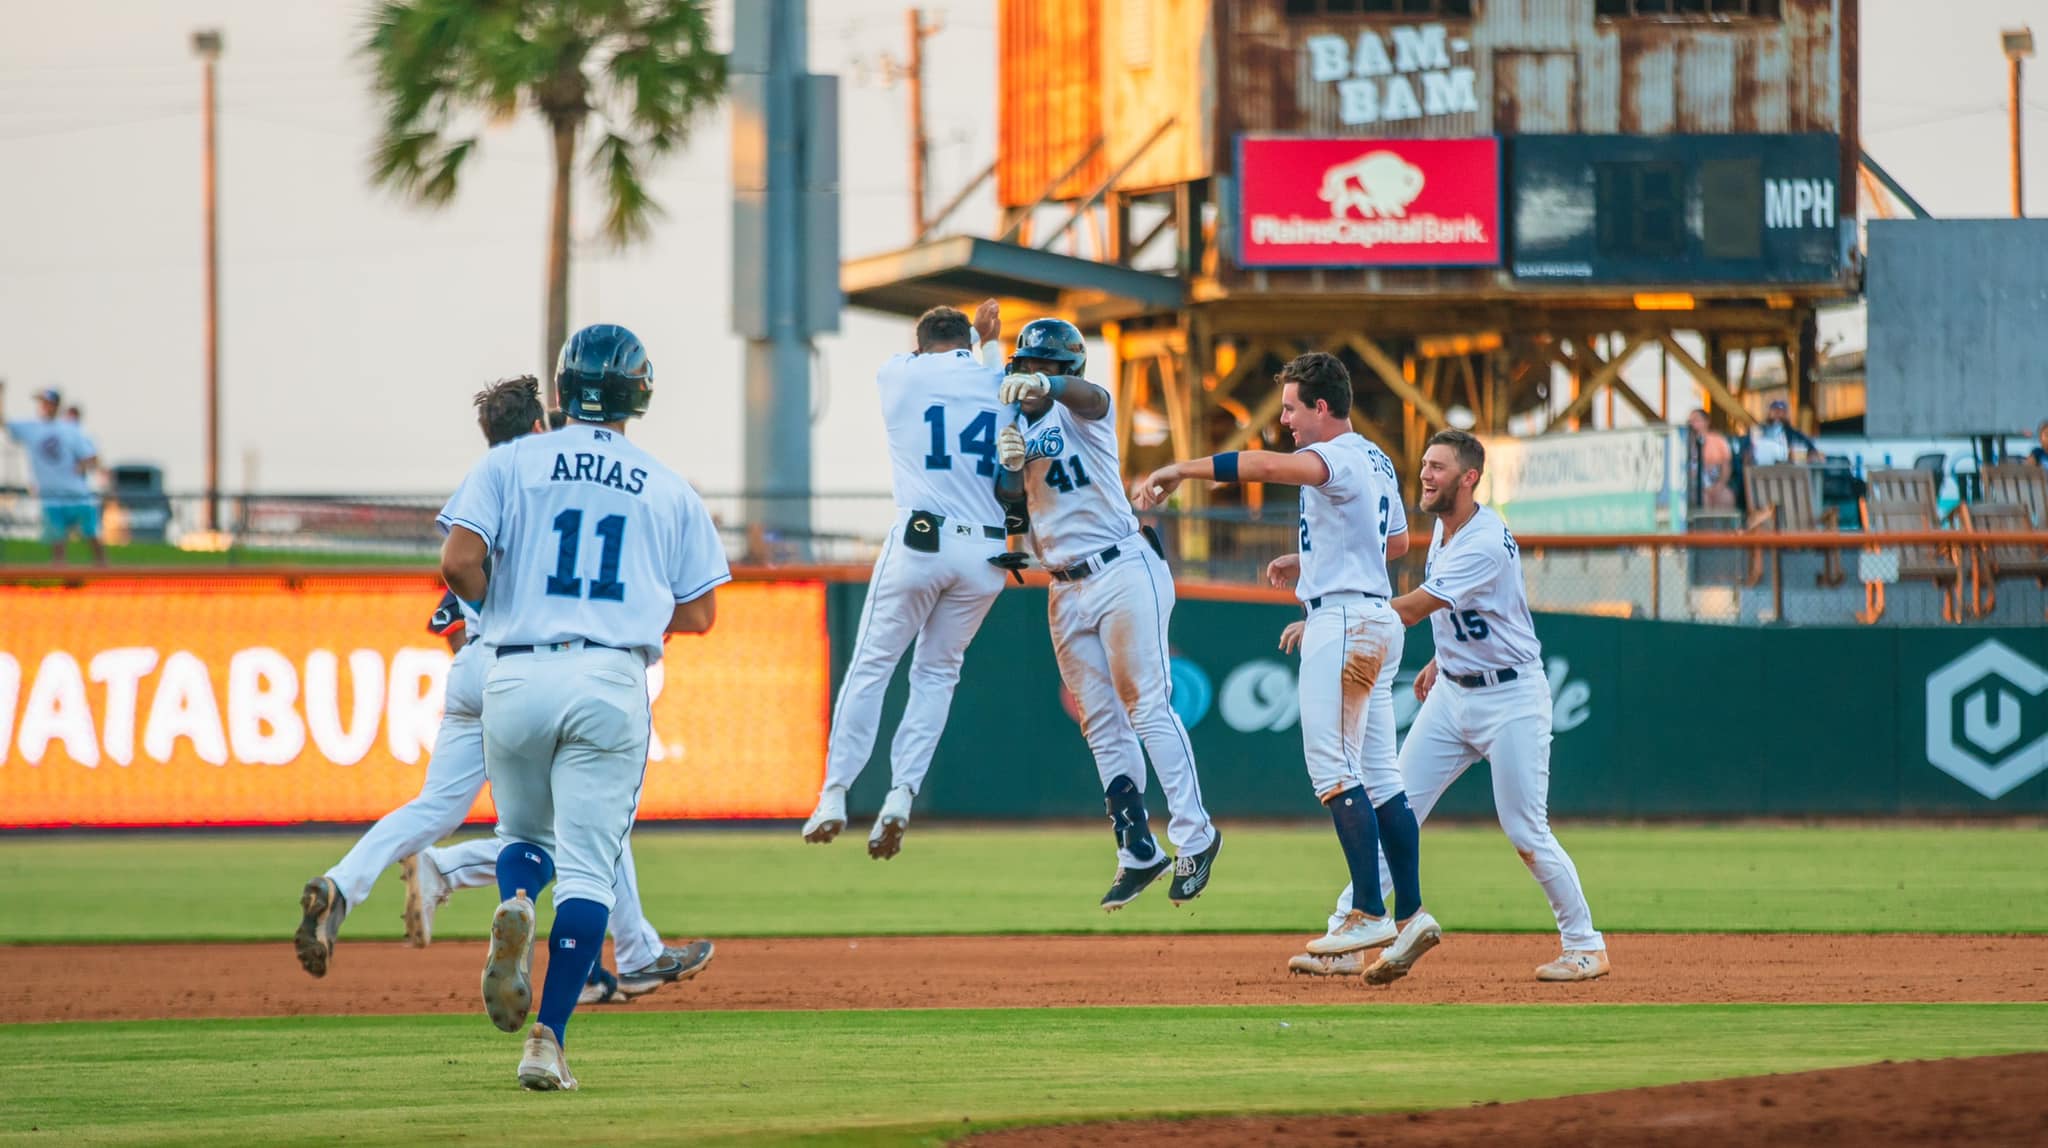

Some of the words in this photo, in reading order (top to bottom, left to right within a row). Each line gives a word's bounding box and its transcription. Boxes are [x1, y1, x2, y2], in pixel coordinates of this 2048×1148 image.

[1307, 22, 1469, 82] BAM-
[1337, 66, 1479, 125] BAM
[1764, 178, 1834, 229] MPH
[923, 404, 998, 478] 14
[550, 452, 648, 496] ARIAS
[1045, 454, 1091, 494] 41
[546, 508, 627, 603] 11
[1449, 609, 1490, 642] 15
